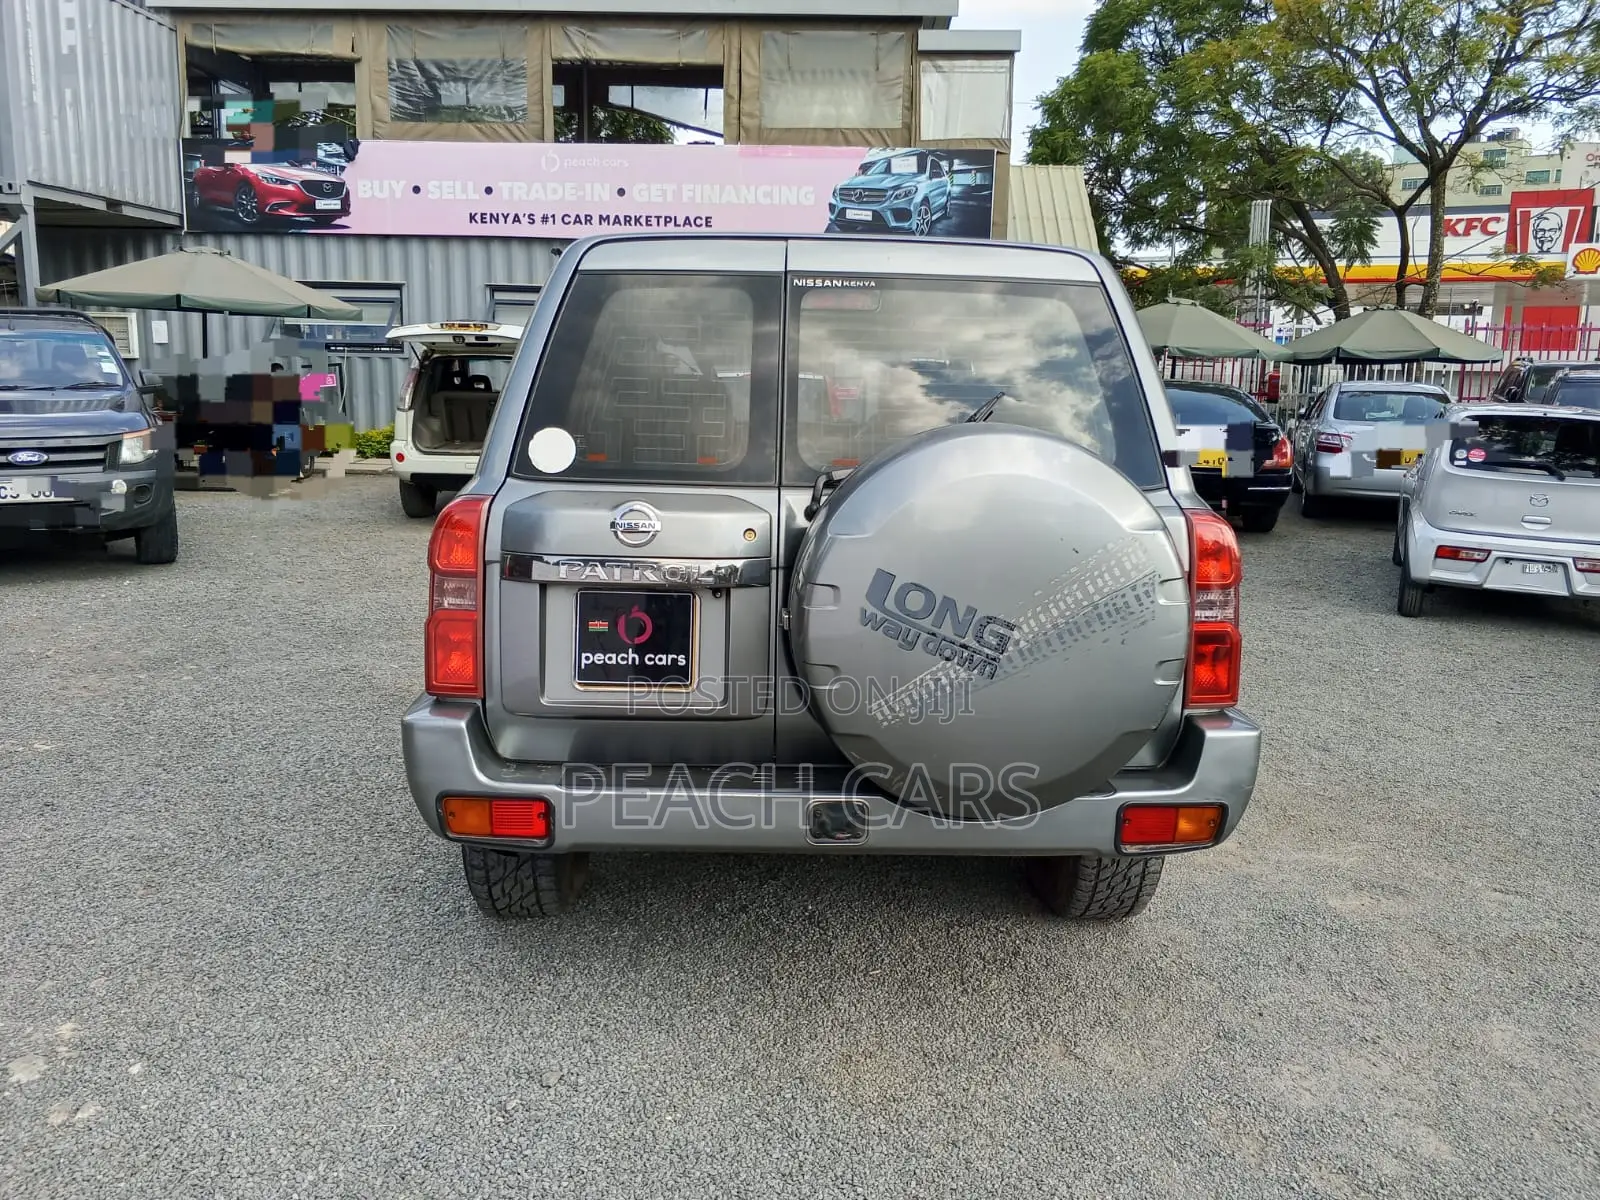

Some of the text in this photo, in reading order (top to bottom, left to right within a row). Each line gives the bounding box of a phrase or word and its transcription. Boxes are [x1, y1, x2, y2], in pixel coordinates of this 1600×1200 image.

[563, 156, 630, 169] peach cars
[357, 179, 815, 206] BUY SELL TRADE-IN GET FINANCING
[469, 211, 713, 229] KENYA'S #1 CAR MARKETPLACE
[1443, 217, 1501, 237] KFC
[793, 278, 876, 288] NISSAN KENYA
[615, 521, 656, 530] NISSAN
[559, 561, 716, 584] PATROL
[865, 567, 1018, 657] LONG
[859, 606, 999, 681] way down
[581, 648, 687, 669] peach cars
